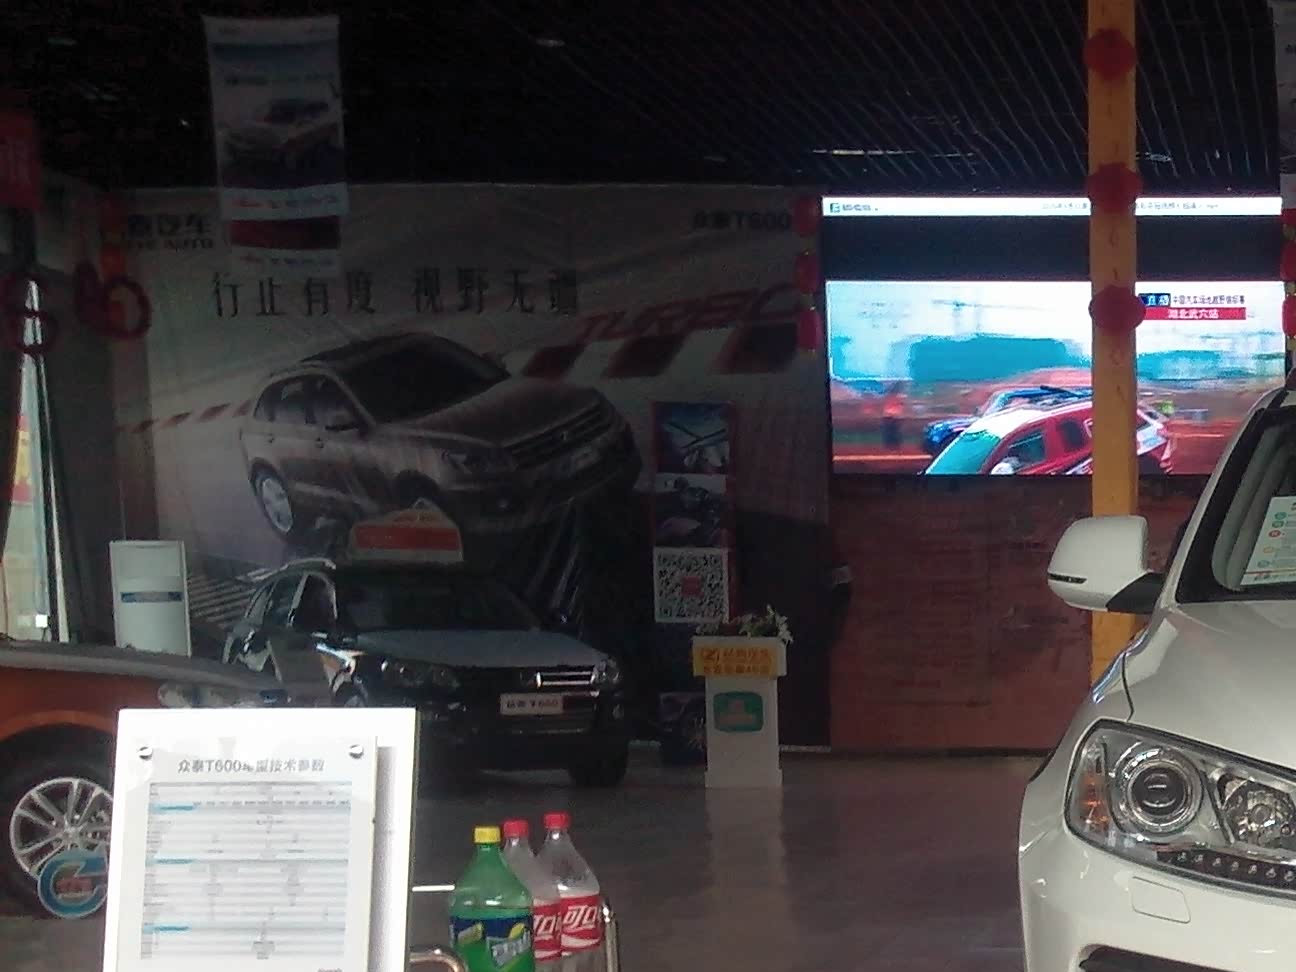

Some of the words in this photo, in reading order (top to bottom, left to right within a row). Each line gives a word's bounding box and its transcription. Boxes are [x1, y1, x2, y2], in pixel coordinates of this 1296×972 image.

[210, 268, 377, 319] 行止有度
[411, 266, 580, 317] 视野无疆
[1167, 308, 1220, 319] 湖北武穴站
